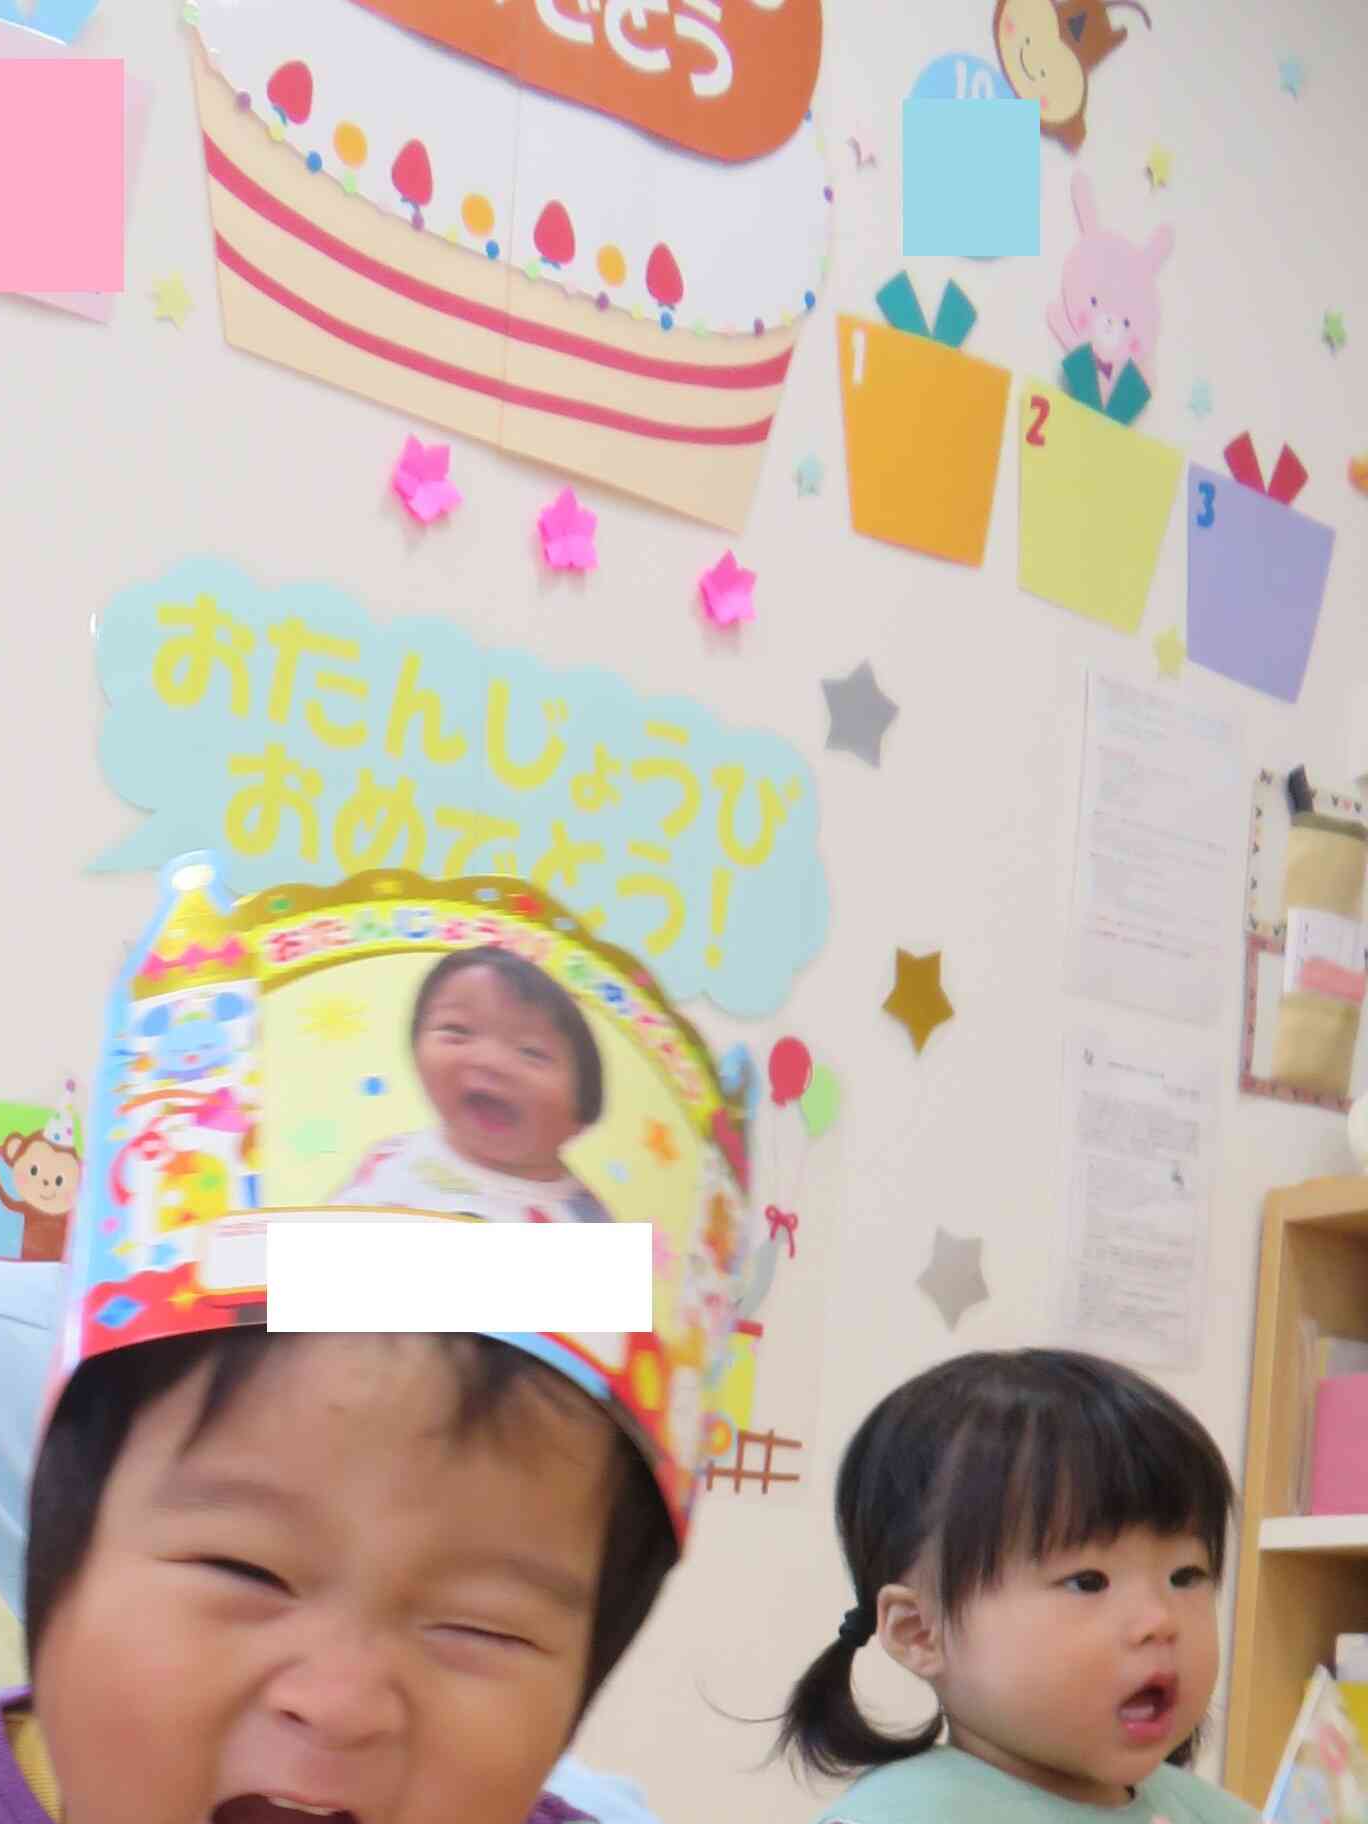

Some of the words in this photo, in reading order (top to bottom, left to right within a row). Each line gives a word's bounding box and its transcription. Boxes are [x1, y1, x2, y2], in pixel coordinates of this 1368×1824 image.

[851, 328, 866, 387] 1
[1025, 395, 1050, 447] 2
[1195, 480, 1216, 529] 3
[151, 593, 802, 868] おたんじょうび
